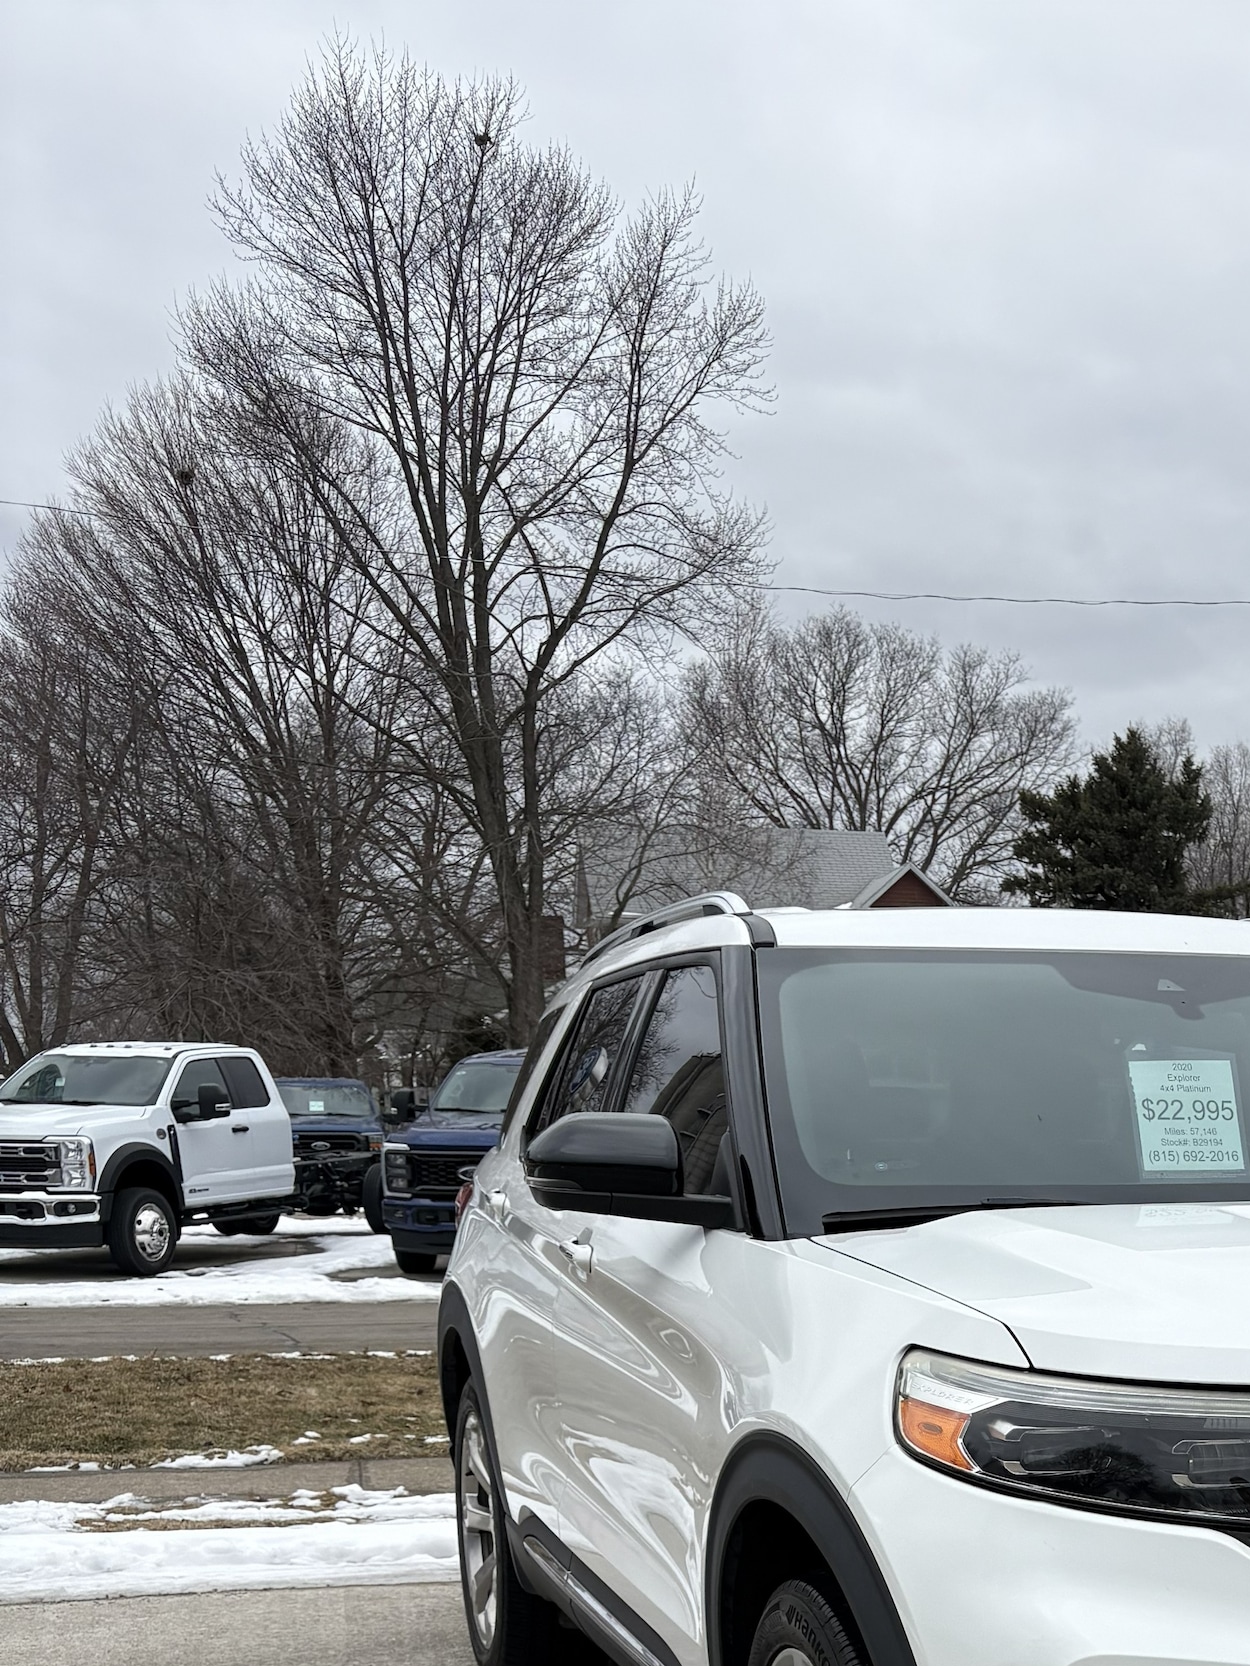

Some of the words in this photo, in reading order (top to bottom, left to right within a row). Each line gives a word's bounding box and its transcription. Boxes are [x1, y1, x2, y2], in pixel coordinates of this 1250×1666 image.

[1171, 1063, 1193, 1071] 2020
[1167, 1073, 1201, 1083] Explorer
[1176, 1084, 1212, 1093] Platinum
[1141, 1098, 1234, 1124] $22,995
[1164, 1127, 1188, 1136] Miles:
[1160, 1138, 1191, 1147] Stock#:
[1148, 1150, 1180, 1165] (815)
[1183, 1150, 1239, 1162] 692-2016
